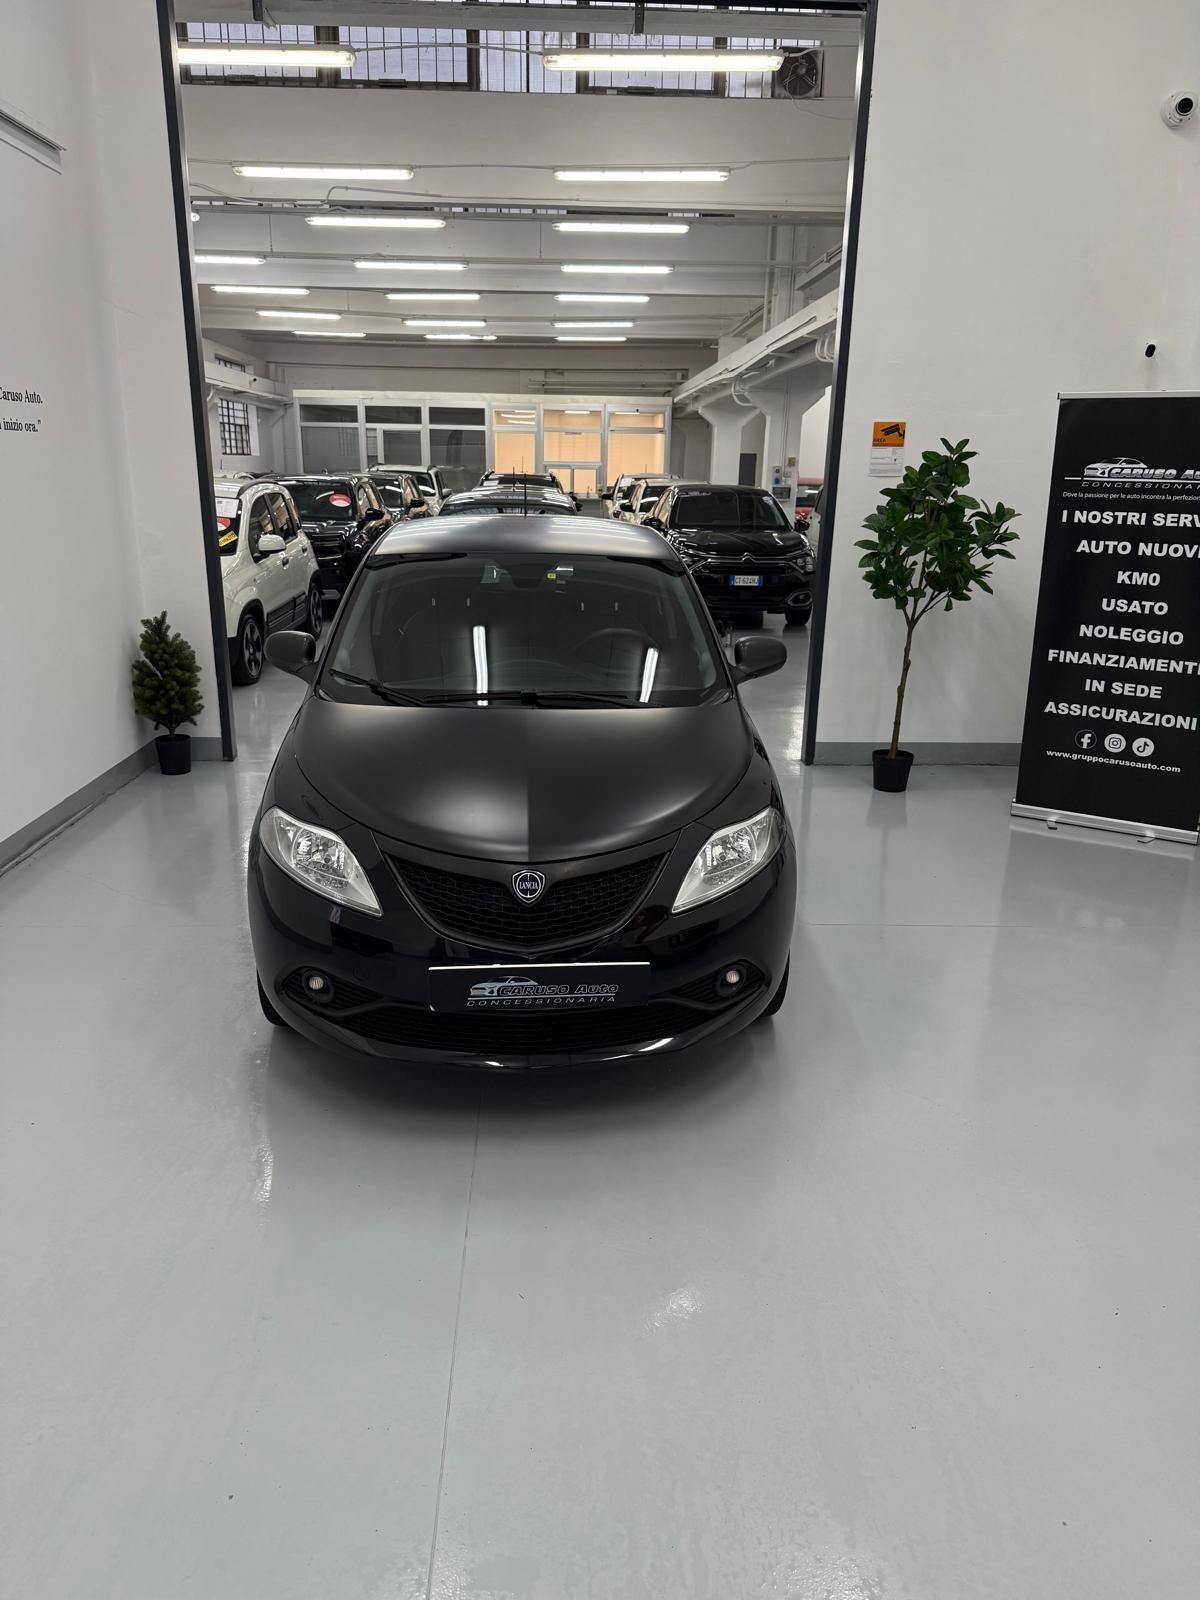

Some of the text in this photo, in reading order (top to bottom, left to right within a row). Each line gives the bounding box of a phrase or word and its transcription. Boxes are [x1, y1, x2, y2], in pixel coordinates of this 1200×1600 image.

[24, 389, 43, 404] Auto.
[3, 417, 23, 432] inizio
[1110, 468, 1177, 479] CARUSO
[1062, 510, 1068, 522] I
[1074, 510, 1147, 526] NOSTRI
[1076, 540, 1132, 555] AUTO
[1101, 598, 1169, 616] USATO
[1079, 624, 1184, 646] NOLEGGIO
[1085, 679, 1163, 699] IN SEDE
[1044, 701, 1198, 731] ASSICURAZIONI
[1046, 750, 1181, 773] www.gruppocarusoauto.com
[519, 881, 539, 890] LANCIA
[500, 985, 569, 995] CARUSO
[466, 996, 616, 1007] CONCESSIONARIA
